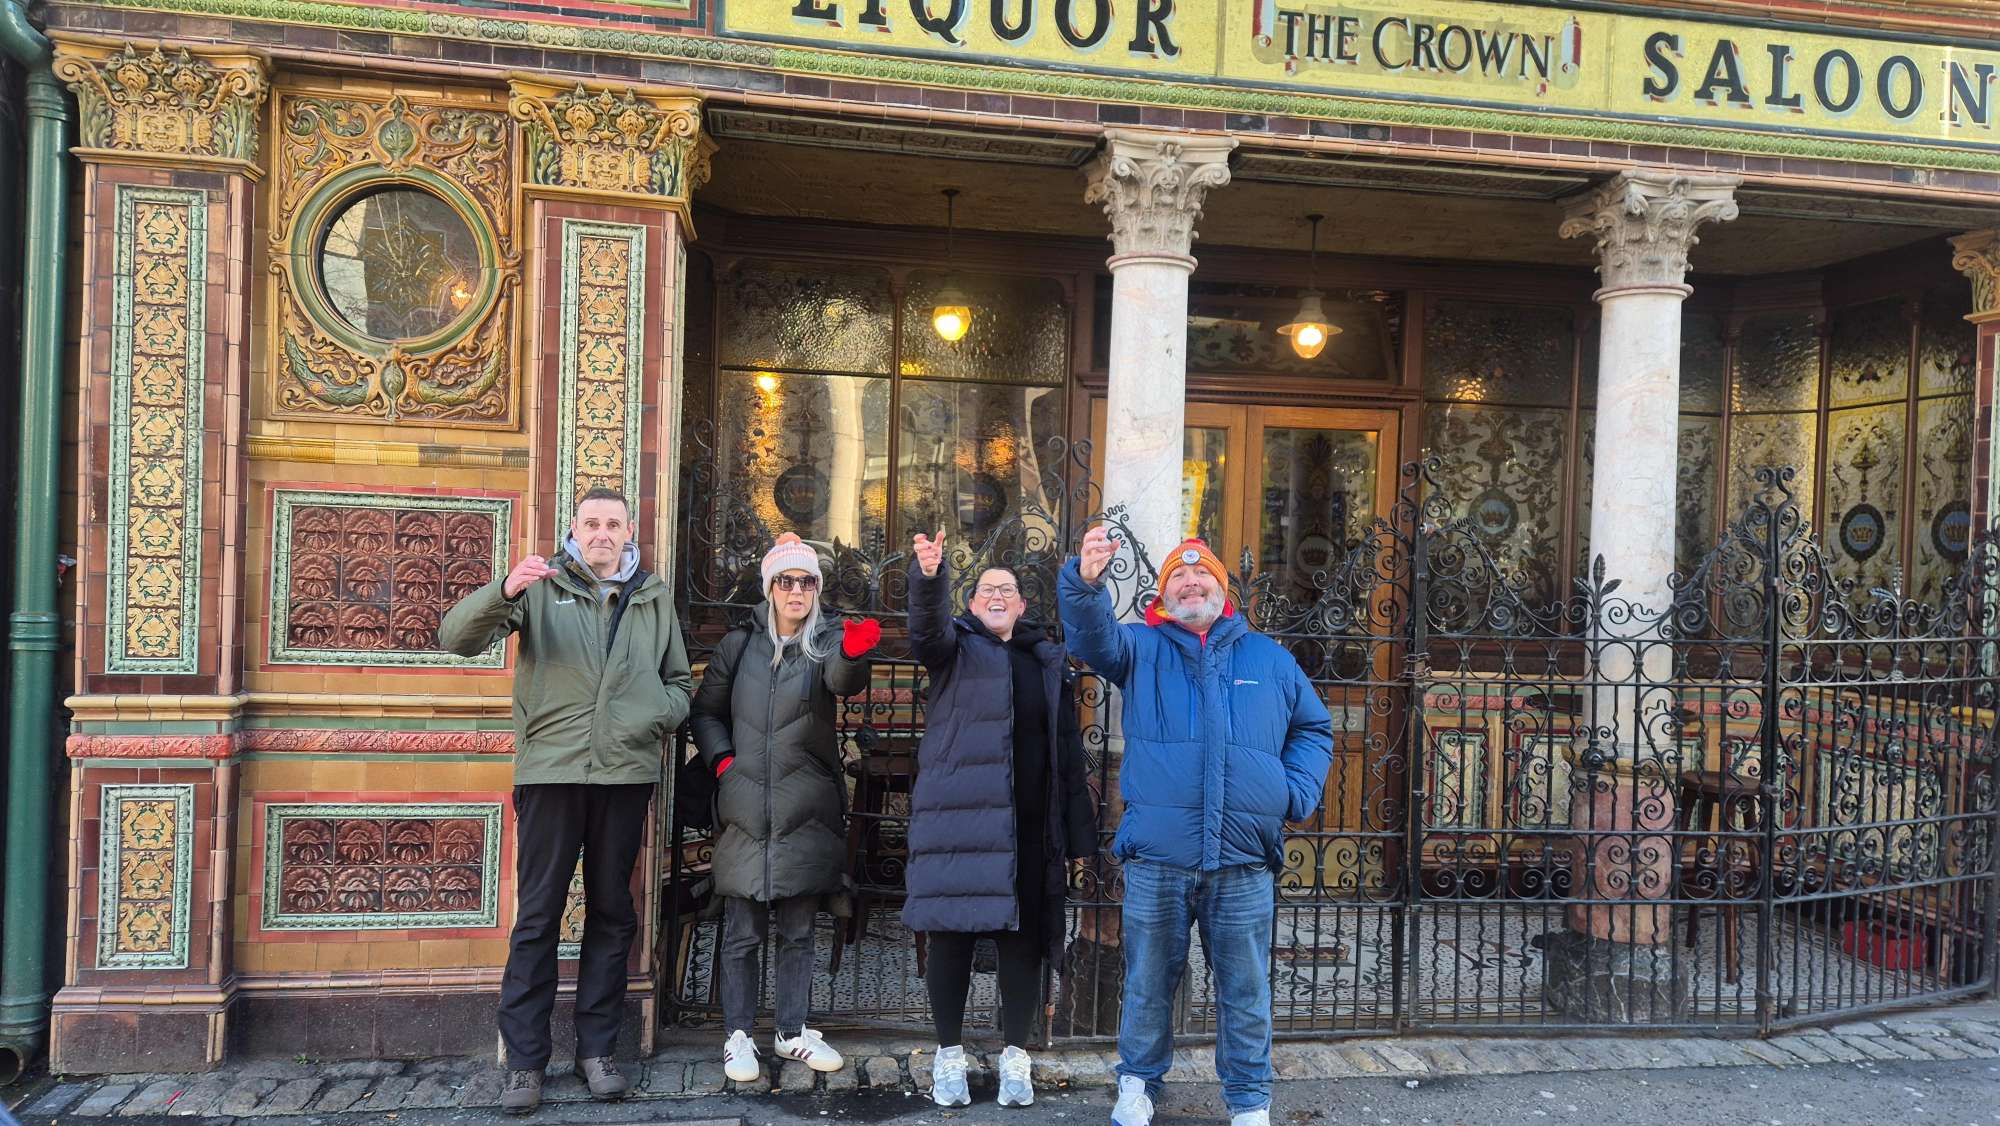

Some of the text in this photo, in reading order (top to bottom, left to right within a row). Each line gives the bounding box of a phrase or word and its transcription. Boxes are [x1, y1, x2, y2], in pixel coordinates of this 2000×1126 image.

[791, 0, 1182, 57] QUOR
[1278, 10, 1555, 82] THE CROWN
[1643, 31, 1997, 127] SALOON
